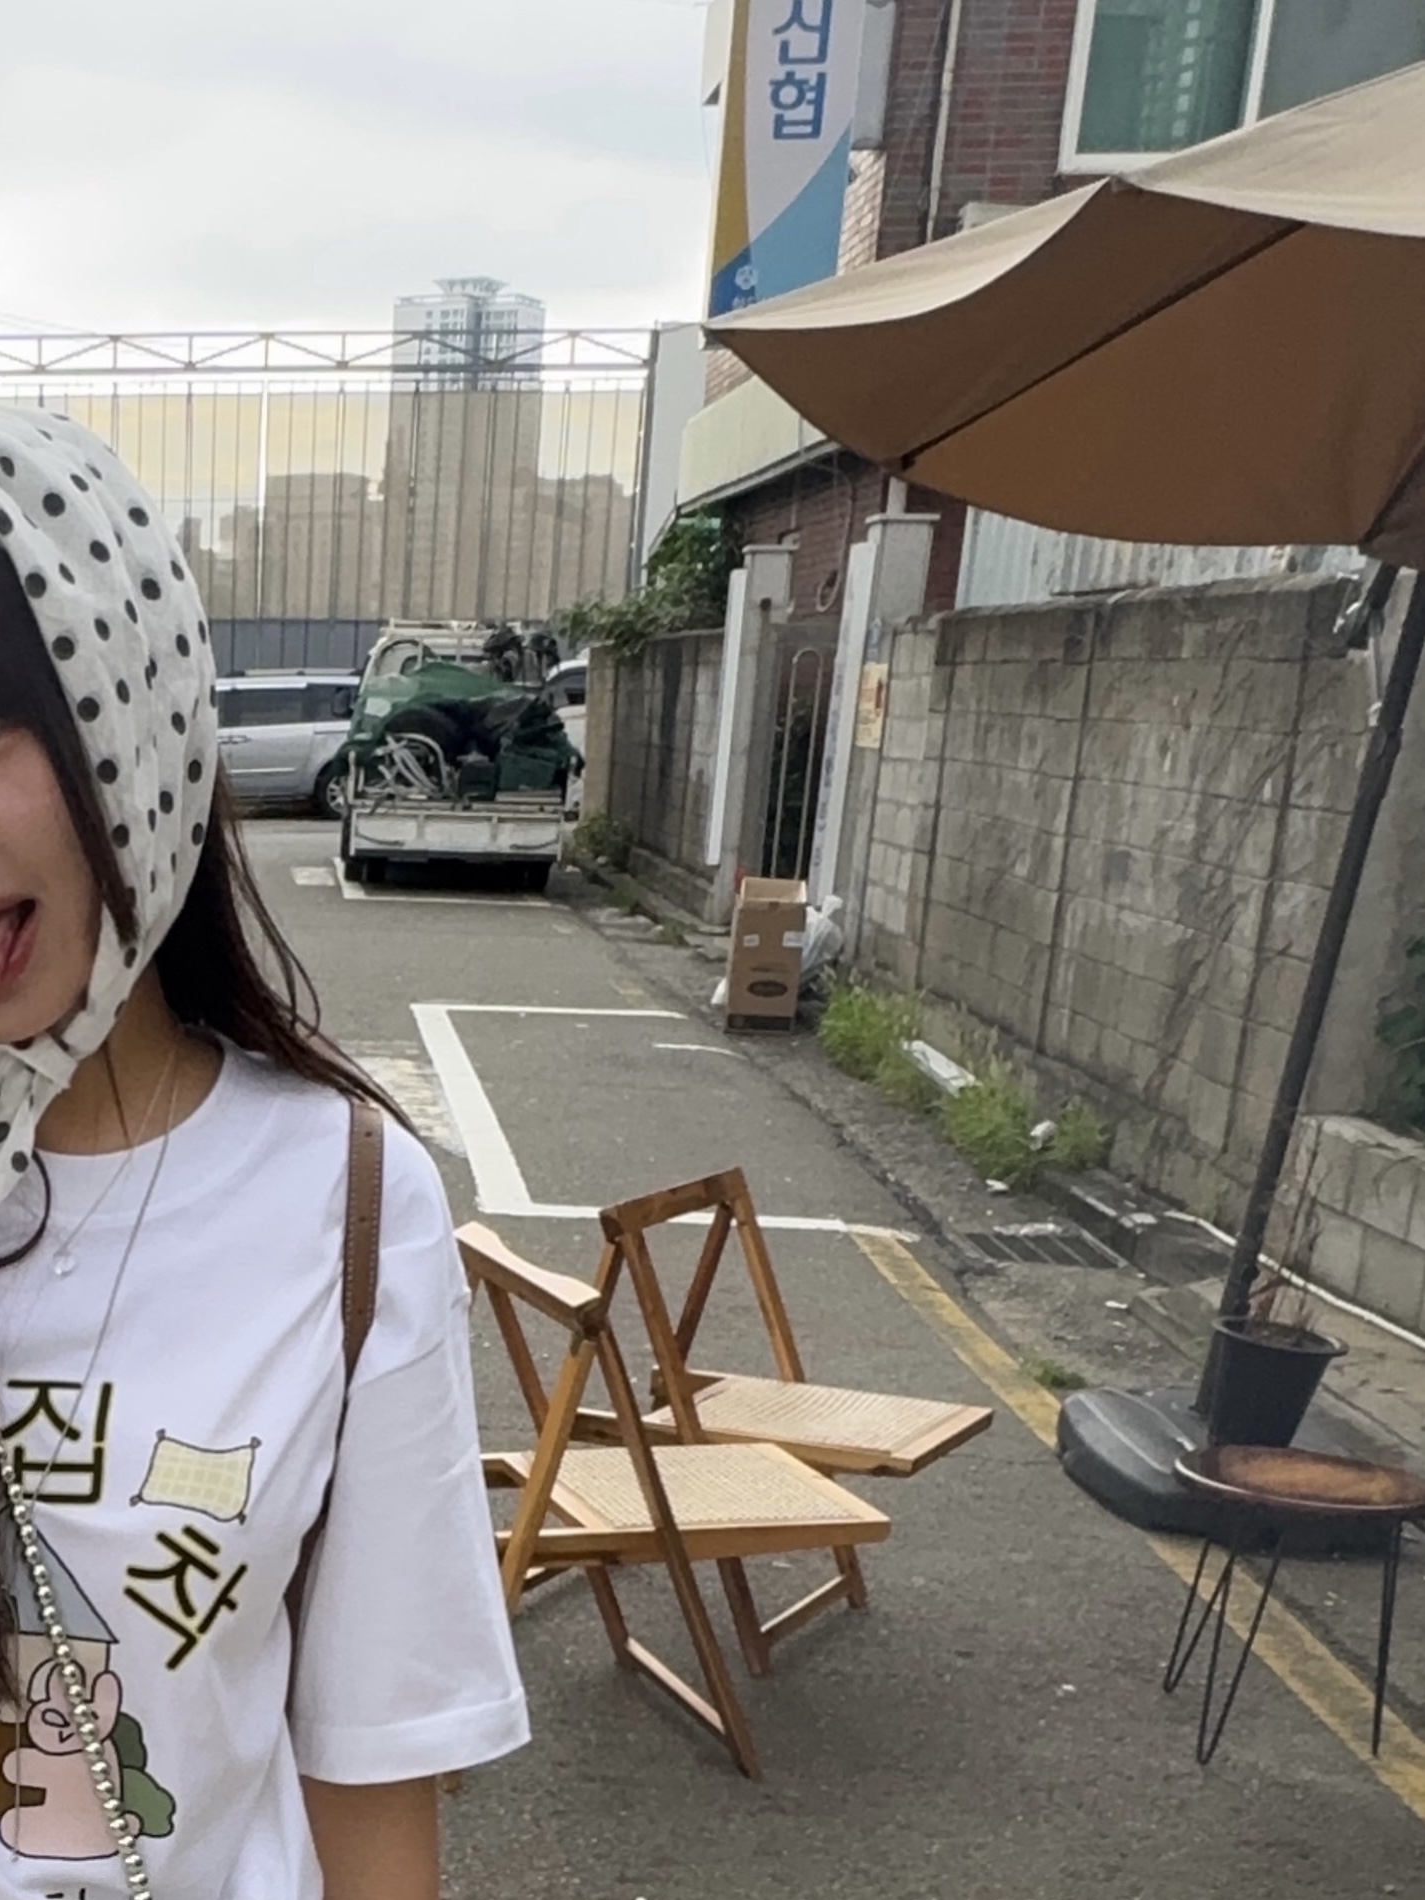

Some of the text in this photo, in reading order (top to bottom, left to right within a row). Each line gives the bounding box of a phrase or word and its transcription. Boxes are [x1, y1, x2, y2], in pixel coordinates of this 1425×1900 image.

[769, 0, 833, 140] 신협
[1, 1380, 249, 1671] 집 착
